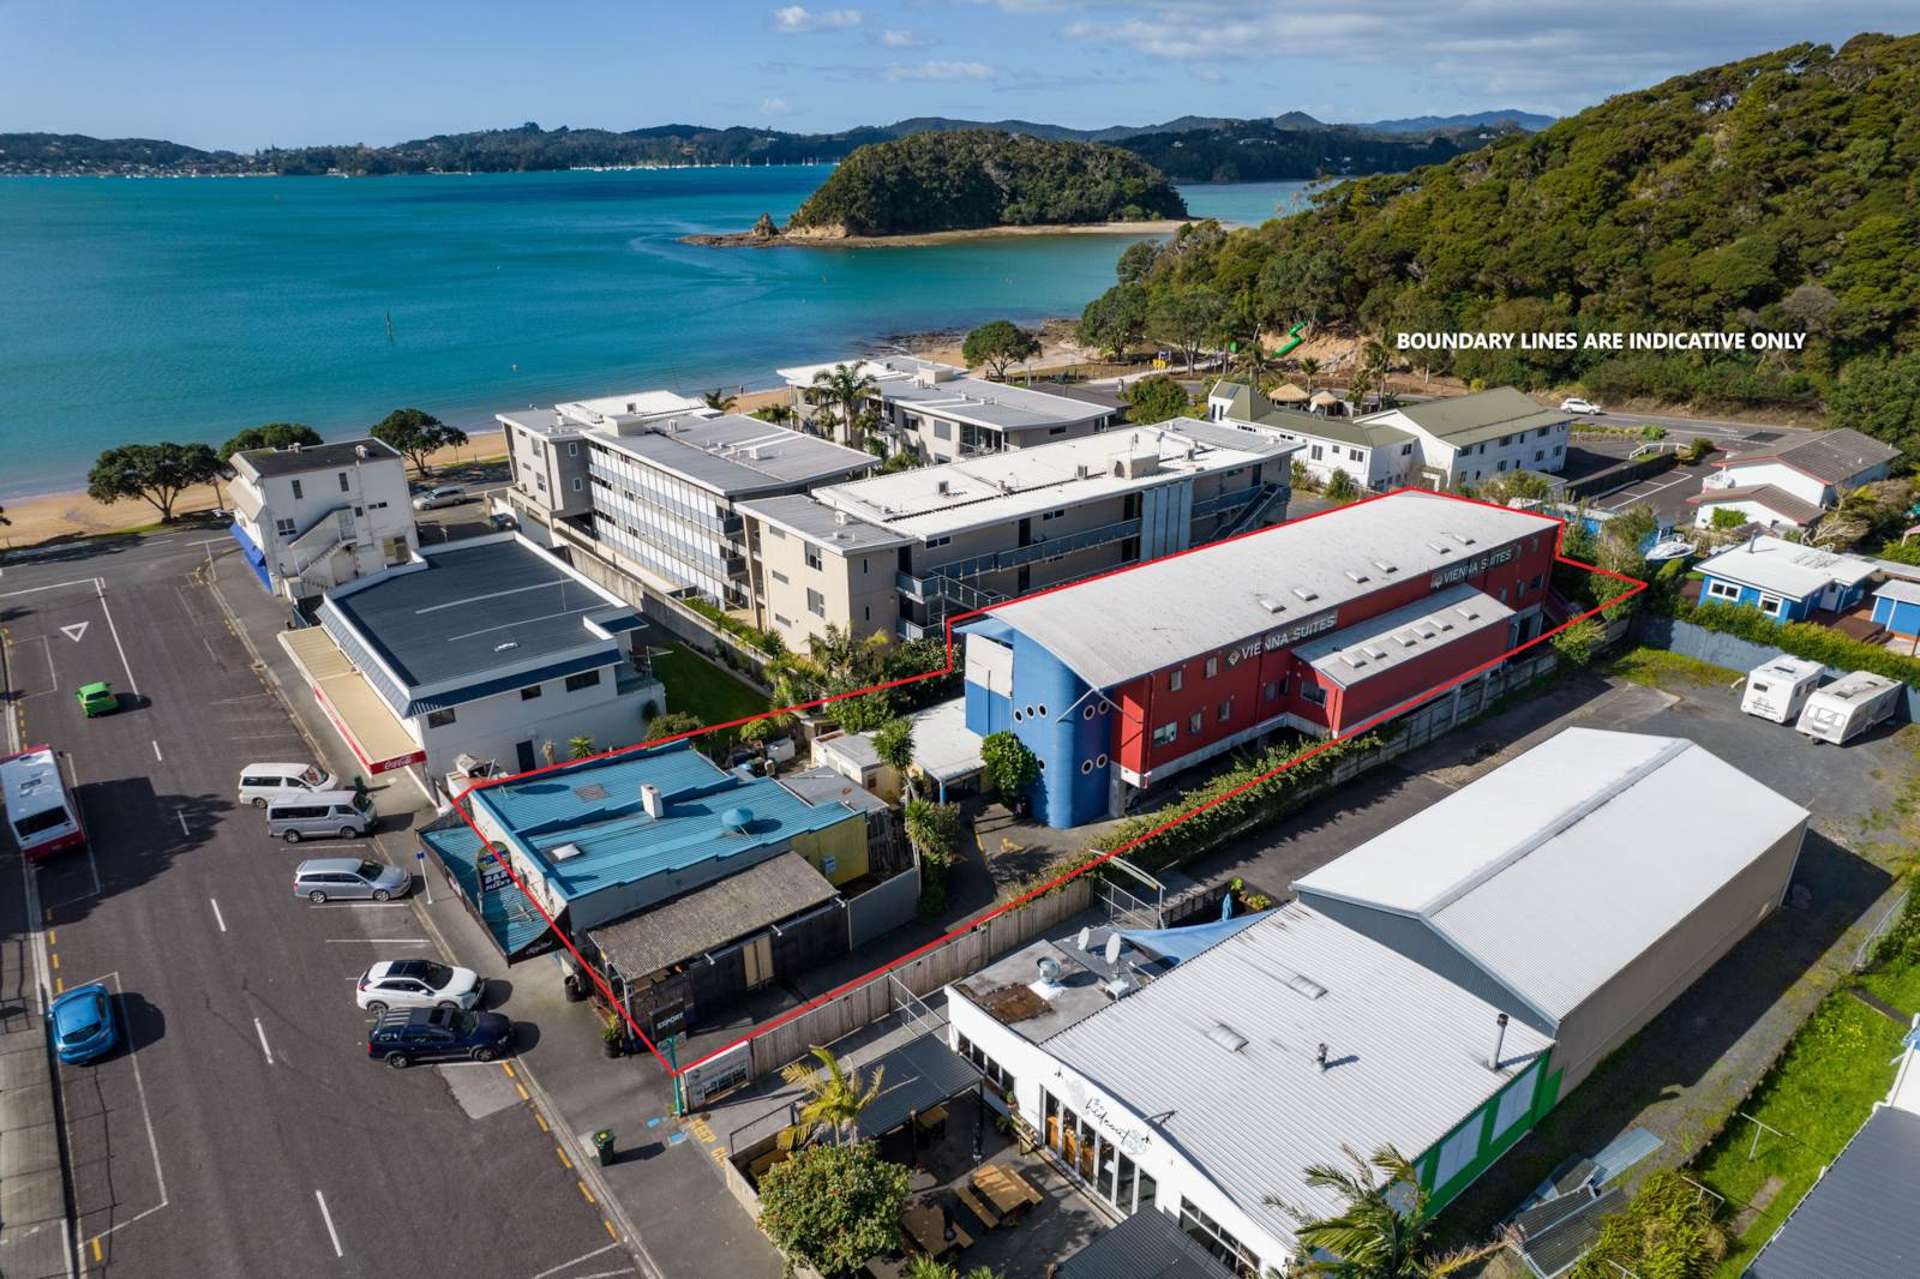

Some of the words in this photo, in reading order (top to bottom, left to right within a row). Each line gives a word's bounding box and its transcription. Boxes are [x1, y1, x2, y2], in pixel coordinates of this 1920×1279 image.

[1241, 633, 1289, 659] VIENNA
[1292, 616, 1336, 640] SUITES
[485, 870, 509, 884] BAR
[657, 1012, 684, 1029] EXPORT
